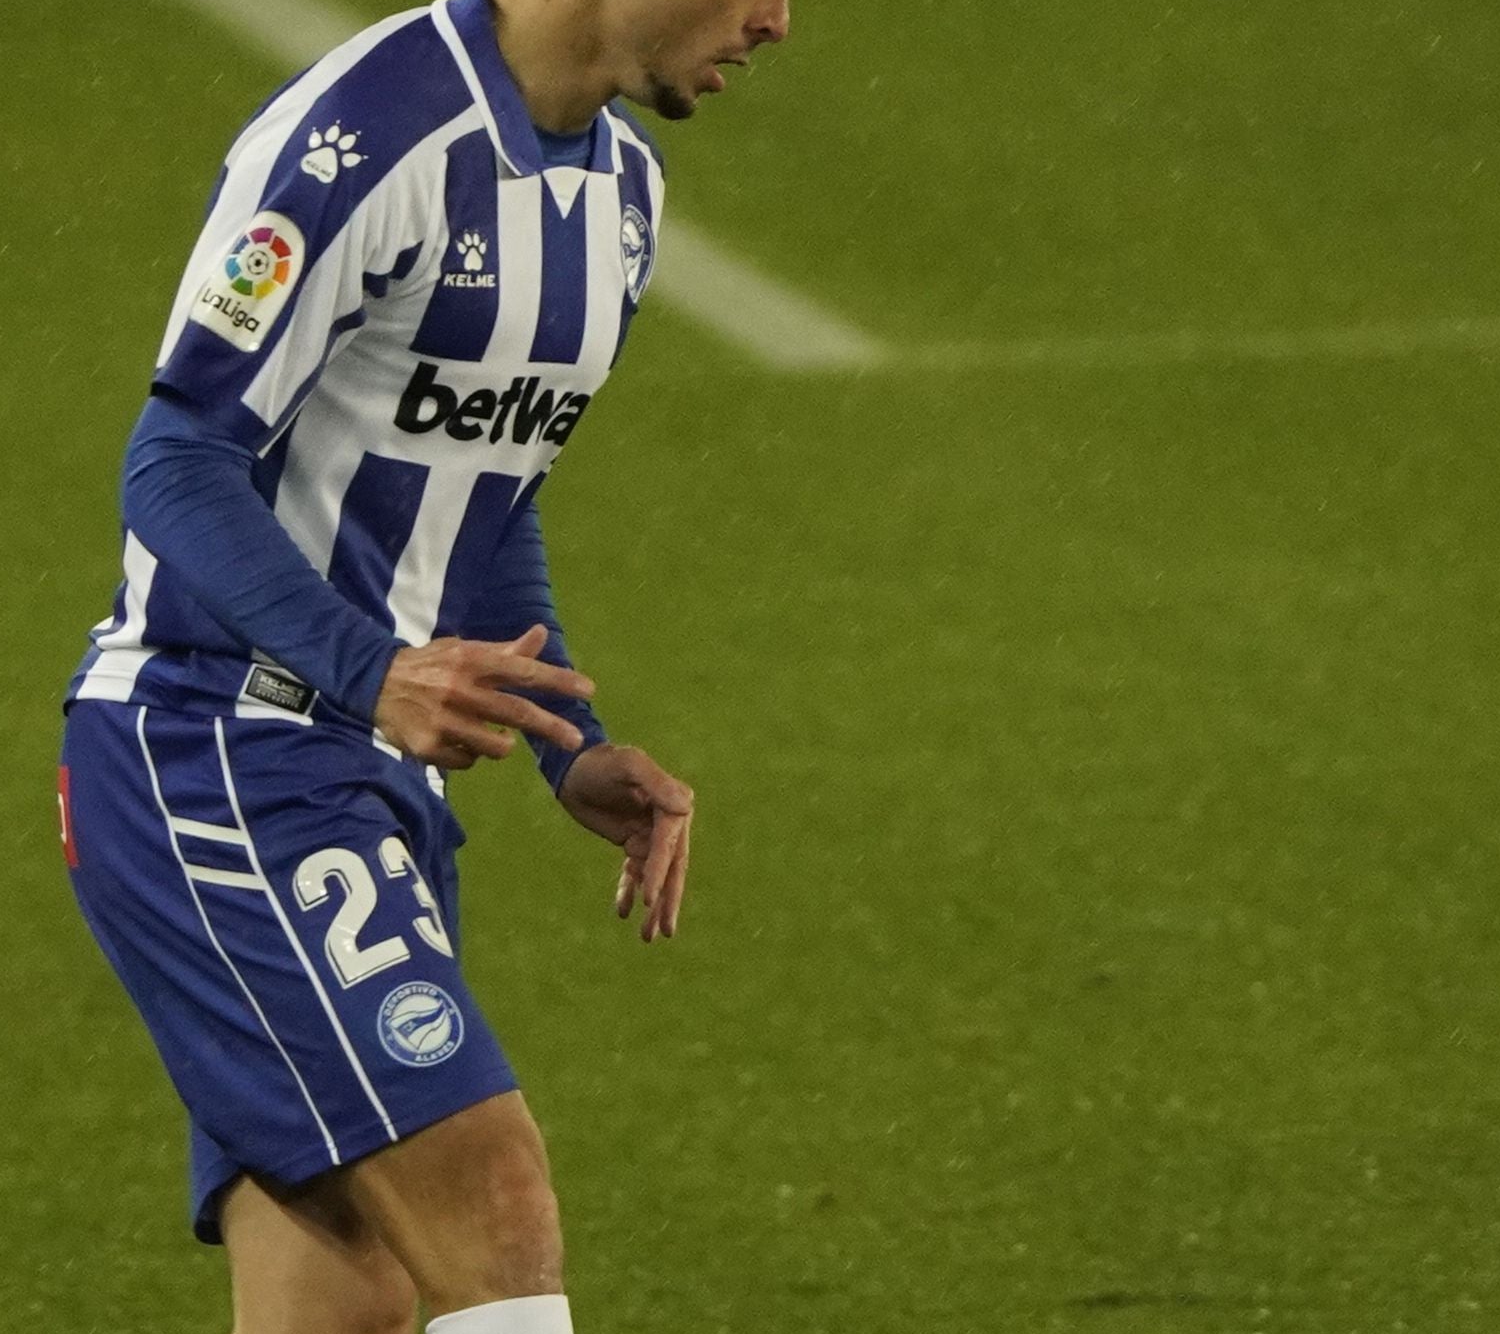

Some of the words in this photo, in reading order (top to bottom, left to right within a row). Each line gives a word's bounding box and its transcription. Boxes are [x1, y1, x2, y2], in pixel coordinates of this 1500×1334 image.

[202, 287, 260, 333] LaLiga
[443, 273, 496, 287] KELME
[393, 360, 591, 457] betwa
[293, 835, 455, 990] 23
